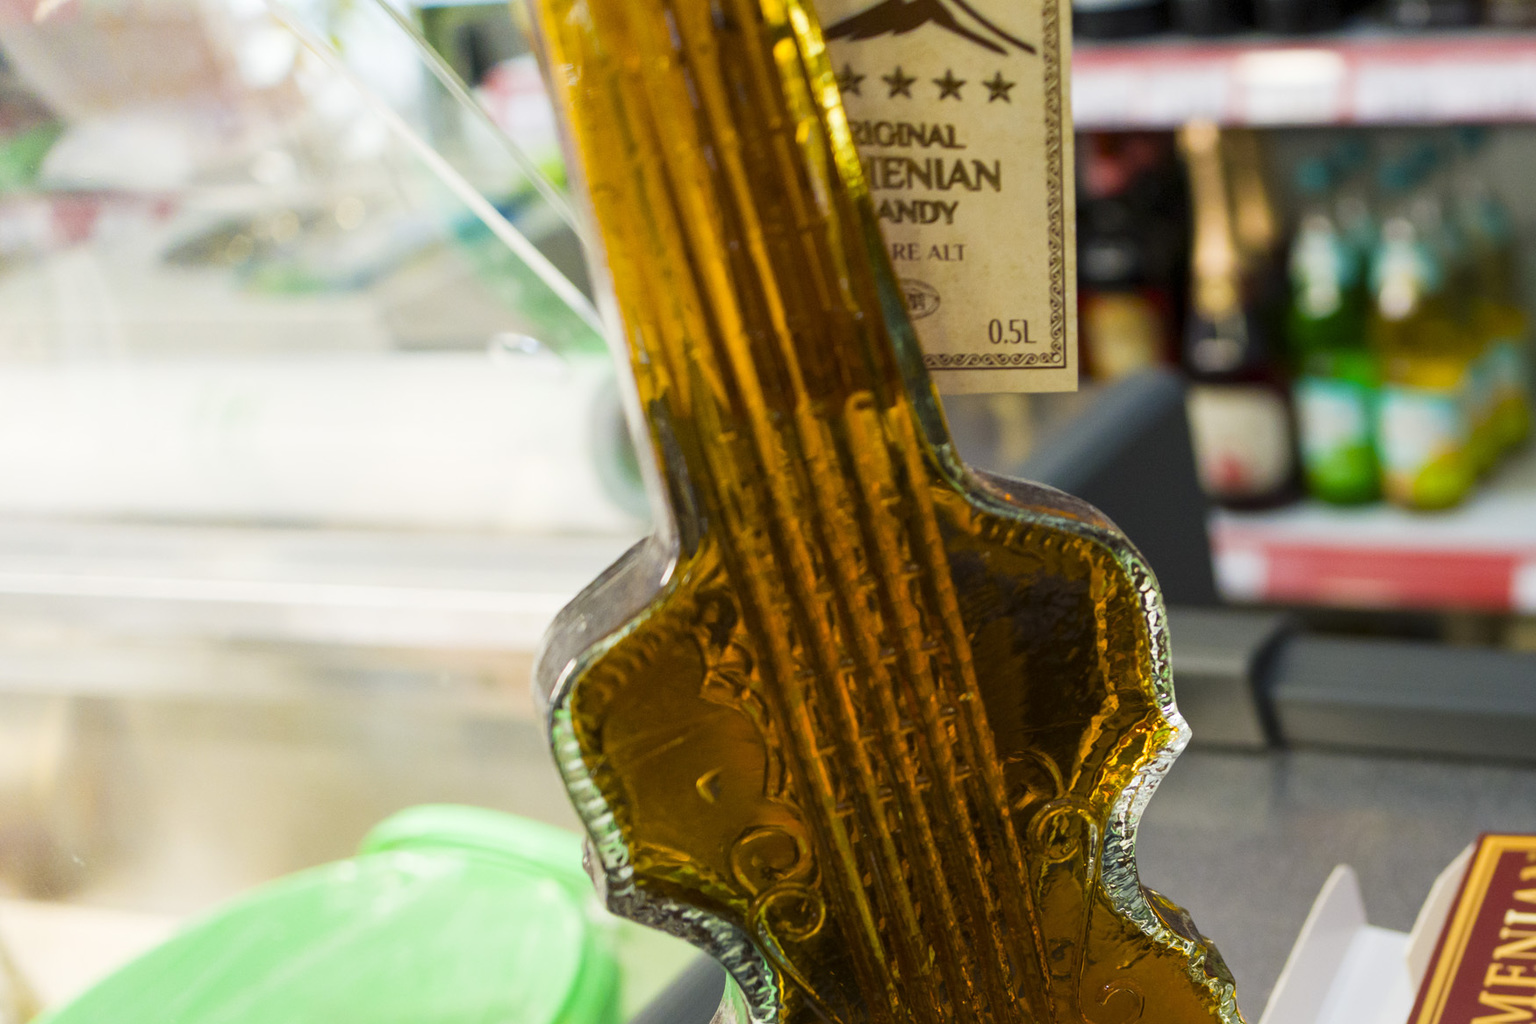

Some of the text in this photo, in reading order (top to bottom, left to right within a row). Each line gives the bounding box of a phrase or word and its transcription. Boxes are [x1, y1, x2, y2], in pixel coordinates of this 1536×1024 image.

[848, 119, 967, 150] RIGINAL
[879, 199, 959, 225] ANDY
[927, 243, 967, 261] ALT
[988, 318, 1037, 344] 0.5L
